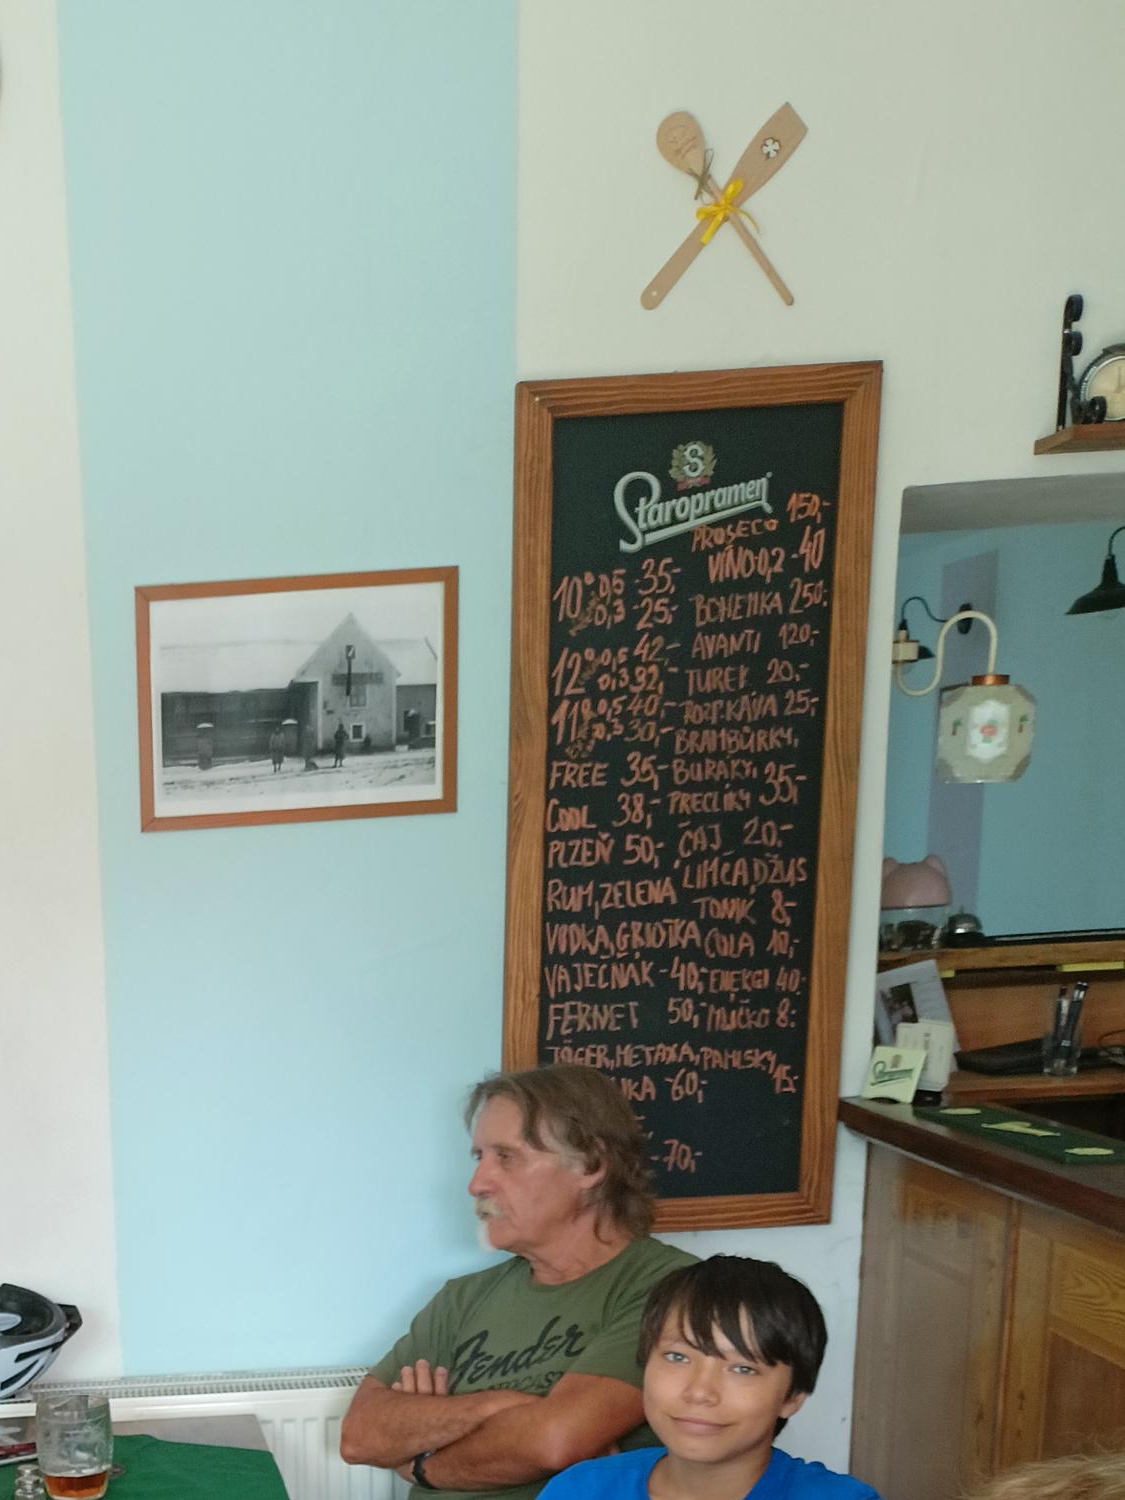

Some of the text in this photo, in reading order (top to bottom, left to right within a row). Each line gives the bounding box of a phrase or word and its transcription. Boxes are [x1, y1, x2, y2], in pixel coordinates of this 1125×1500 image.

[682, 443, 705, 478] S
[613, 471, 773, 553] Staropramen
[692, 629, 762, 660] AVANTI
[549, 760, 609, 790] FREE
[546, 1002, 639, 1041] FERNET
[449, 1315, 587, 1395] Fender
